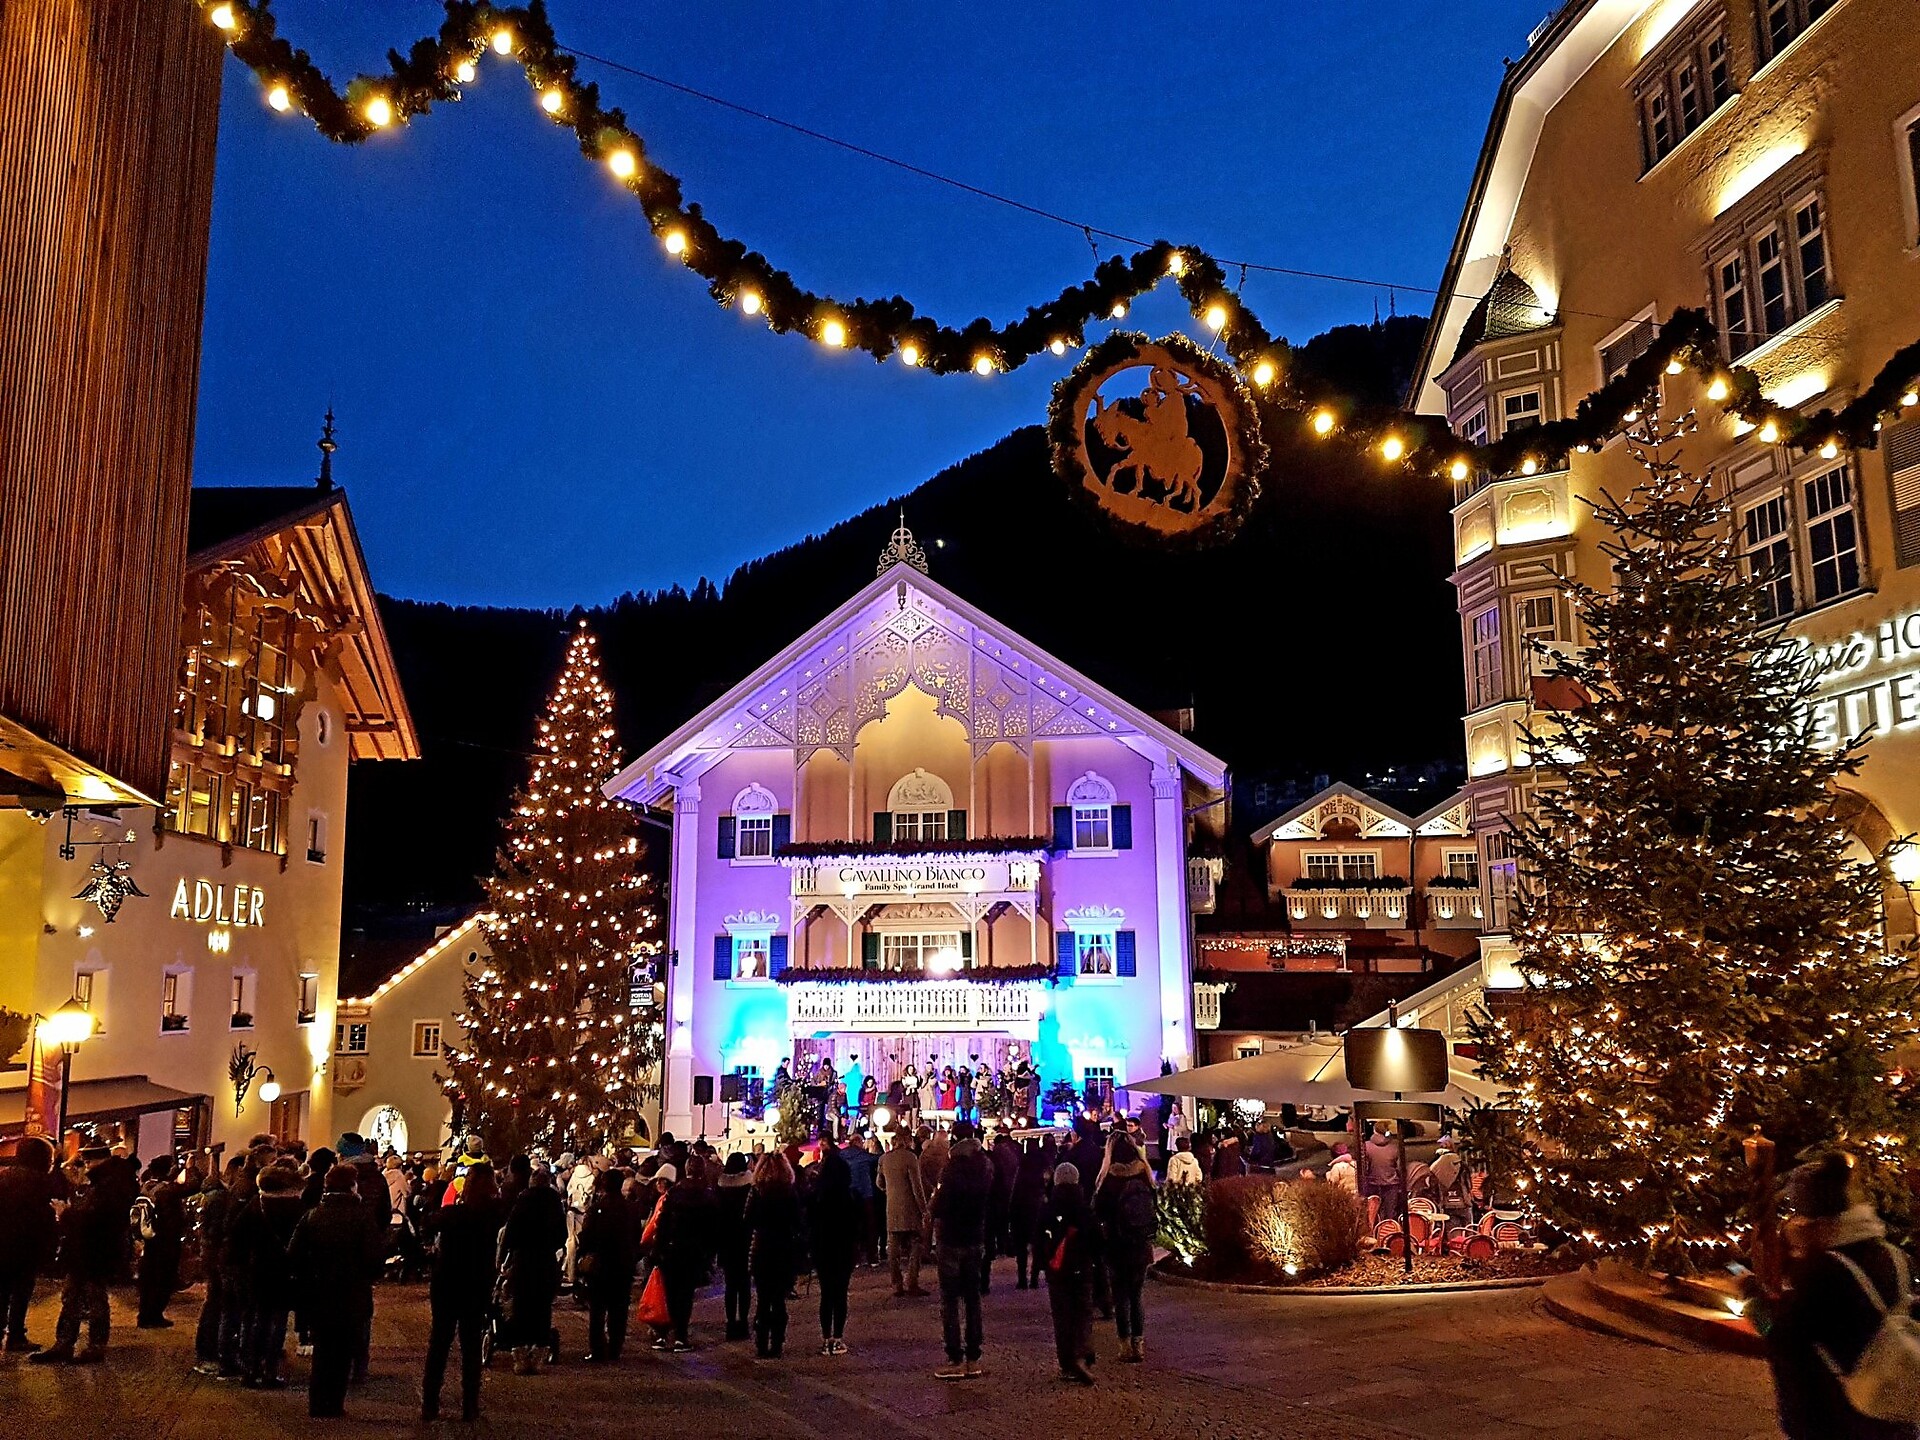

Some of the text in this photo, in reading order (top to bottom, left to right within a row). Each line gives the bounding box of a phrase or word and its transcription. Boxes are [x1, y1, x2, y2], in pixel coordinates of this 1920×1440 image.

[865, 881, 959, 892] Family Spa Grand Hotel
[170, 877, 265, 928] ADLER
